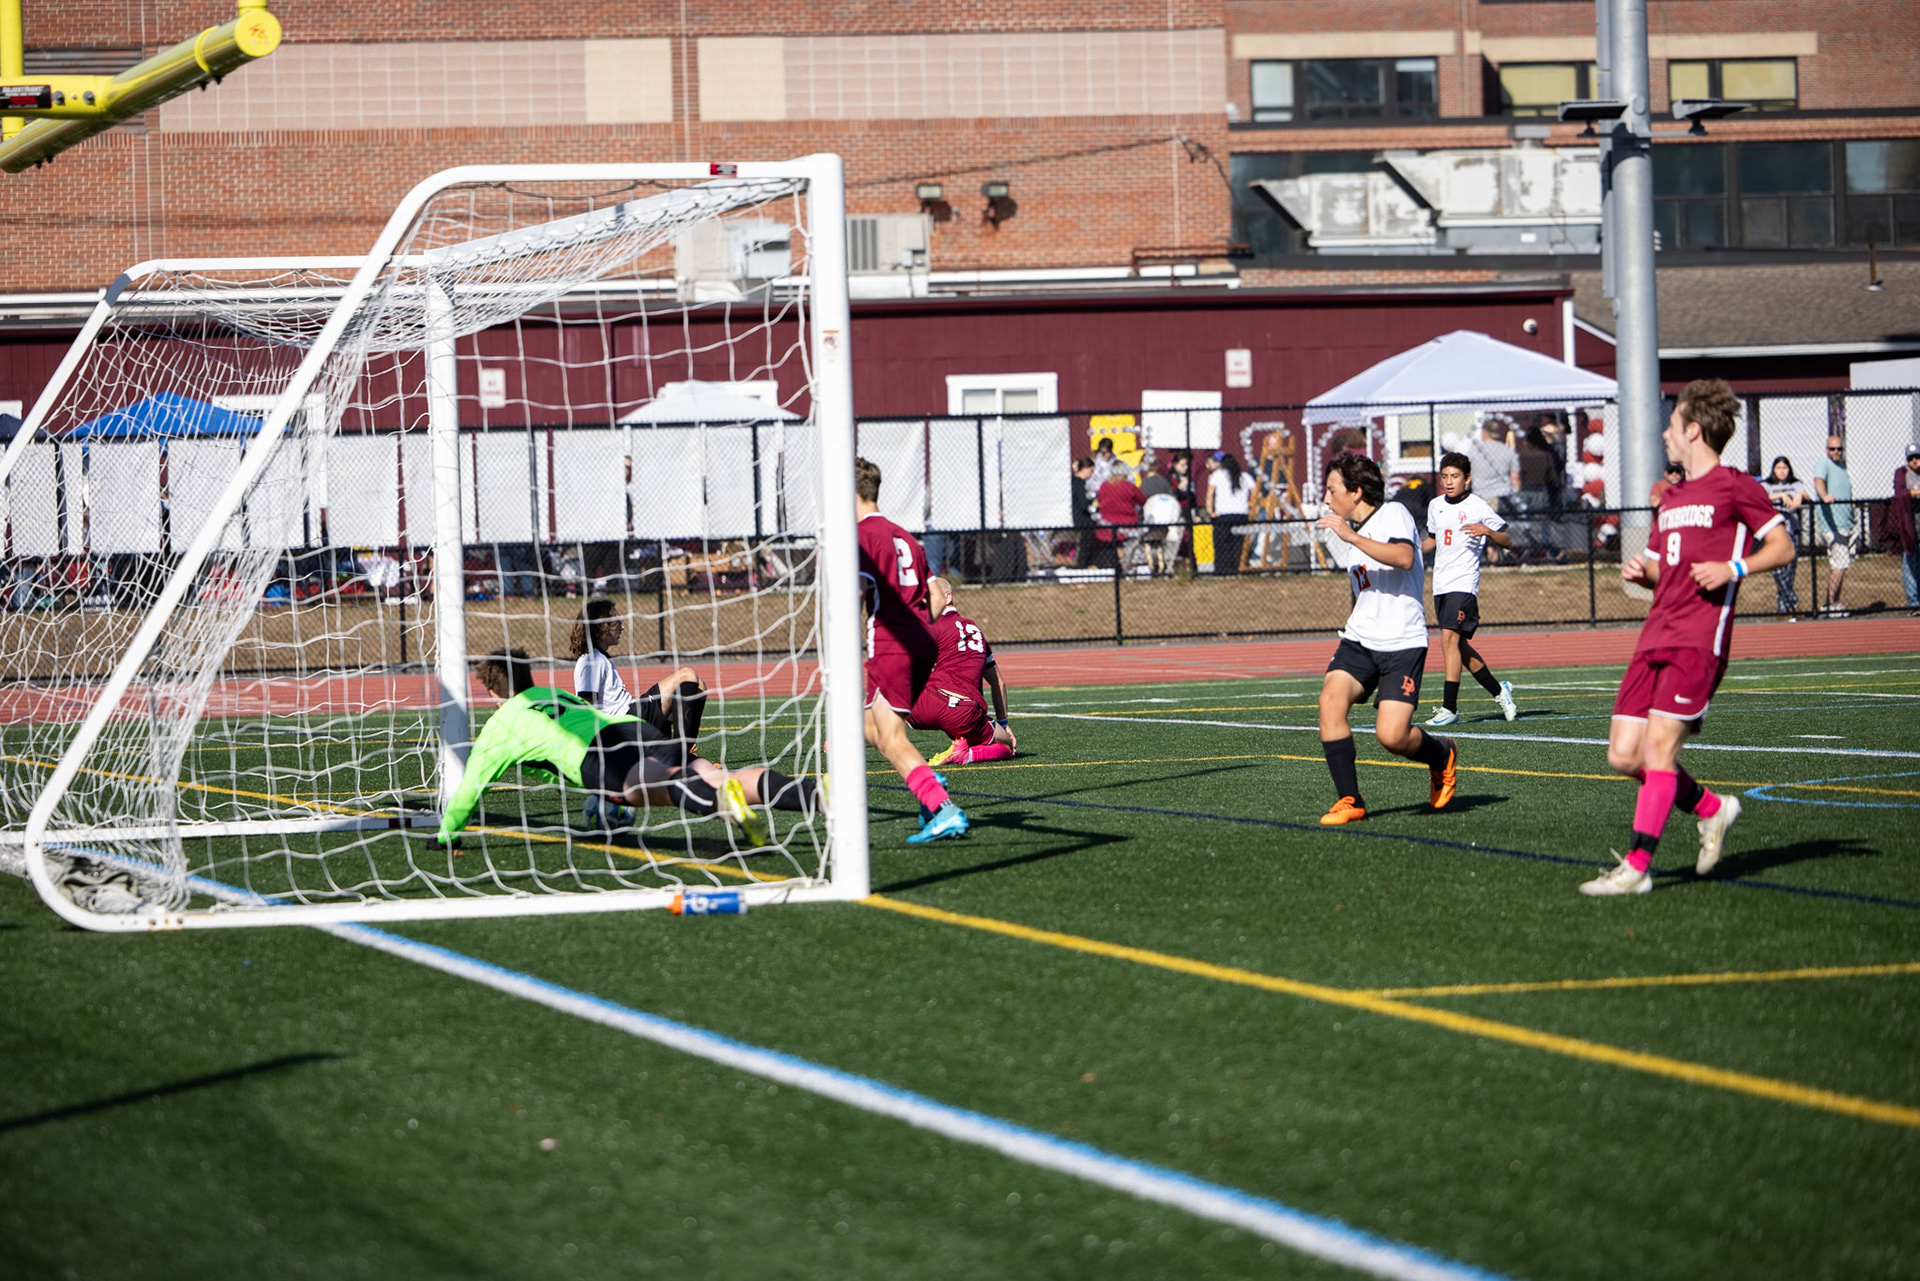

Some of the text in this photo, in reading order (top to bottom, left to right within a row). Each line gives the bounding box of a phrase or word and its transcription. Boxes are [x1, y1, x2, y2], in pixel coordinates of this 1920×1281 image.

[1444, 529, 1453, 546] 6
[1666, 532, 1681, 566] 9
[893, 537, 919, 587] 2
[1353, 564, 1371, 592] 13
[955, 620, 984, 653] 13
